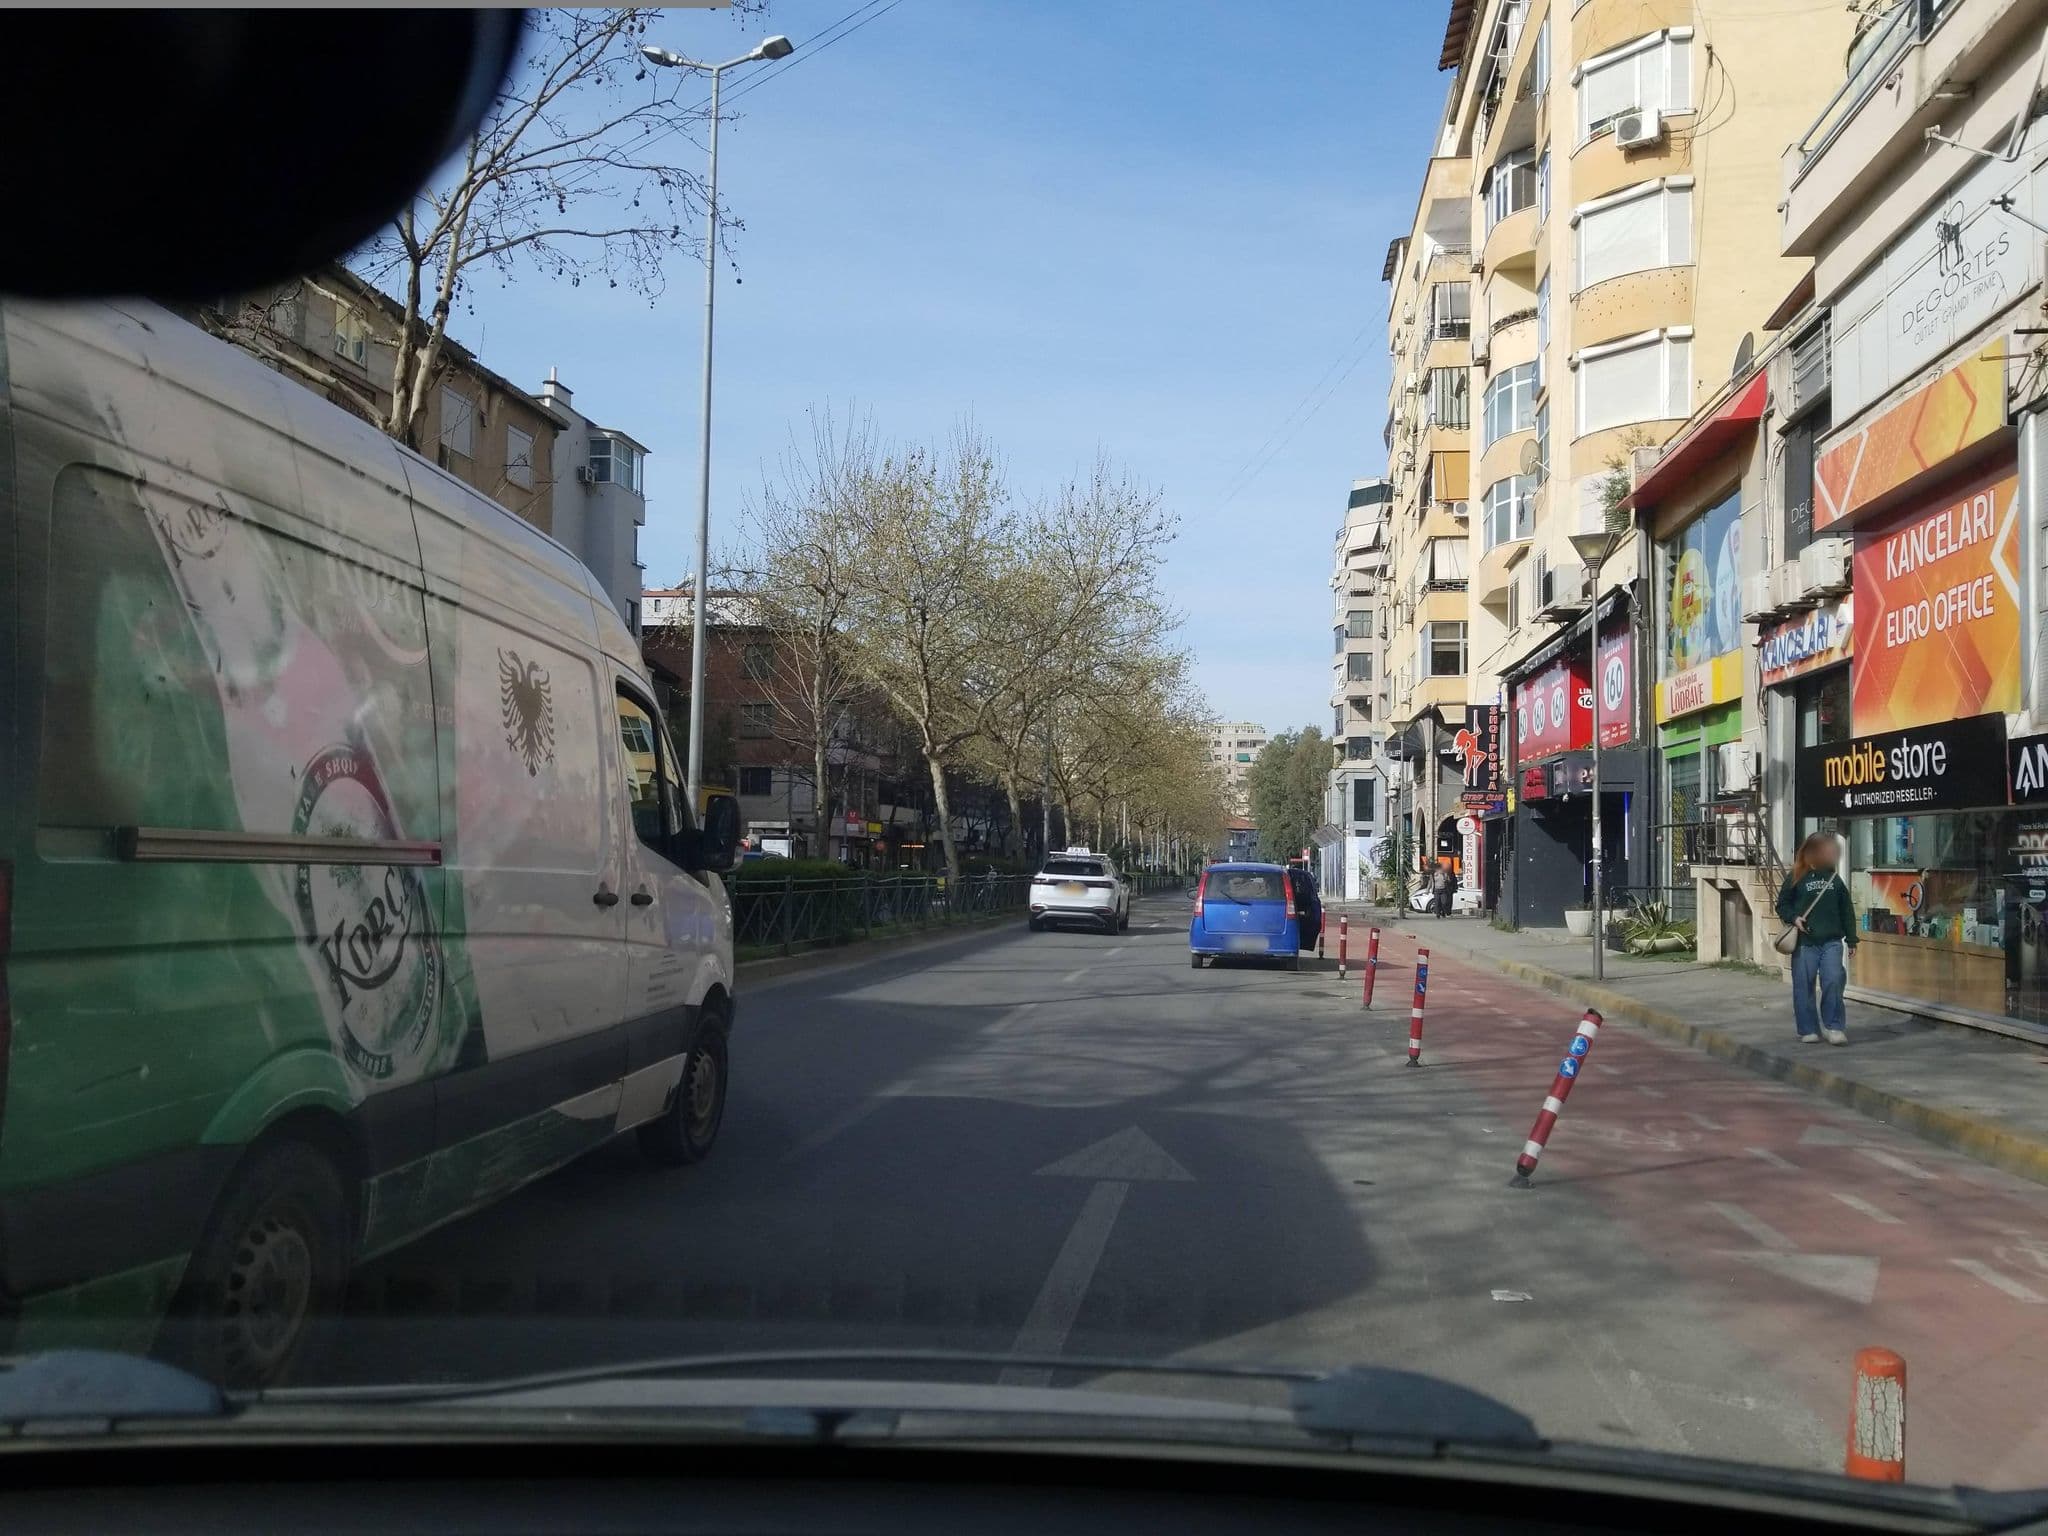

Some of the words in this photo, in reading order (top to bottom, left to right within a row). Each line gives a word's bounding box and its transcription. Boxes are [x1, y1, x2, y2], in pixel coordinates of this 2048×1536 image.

[1903, 231, 2009, 334] DEGORTES
[1886, 489, 1996, 581] KANCELARI
[1886, 600, 1931, 648] EURO
[1933, 574, 1995, 632] OFFICE
[1761, 613, 1830, 672] KANCELARI
[1606, 663, 1623, 705] 160
[1671, 682, 1705, 714] LODRAVE
[1488, 705, 1499, 791] SHQIPONJA
[1825, 741, 1886, 788] mobile
[1891, 737, 1947, 781] store
[1854, 790, 1896, 806] AUTHORIZED
[1896, 786, 1933, 803] RESELLER
